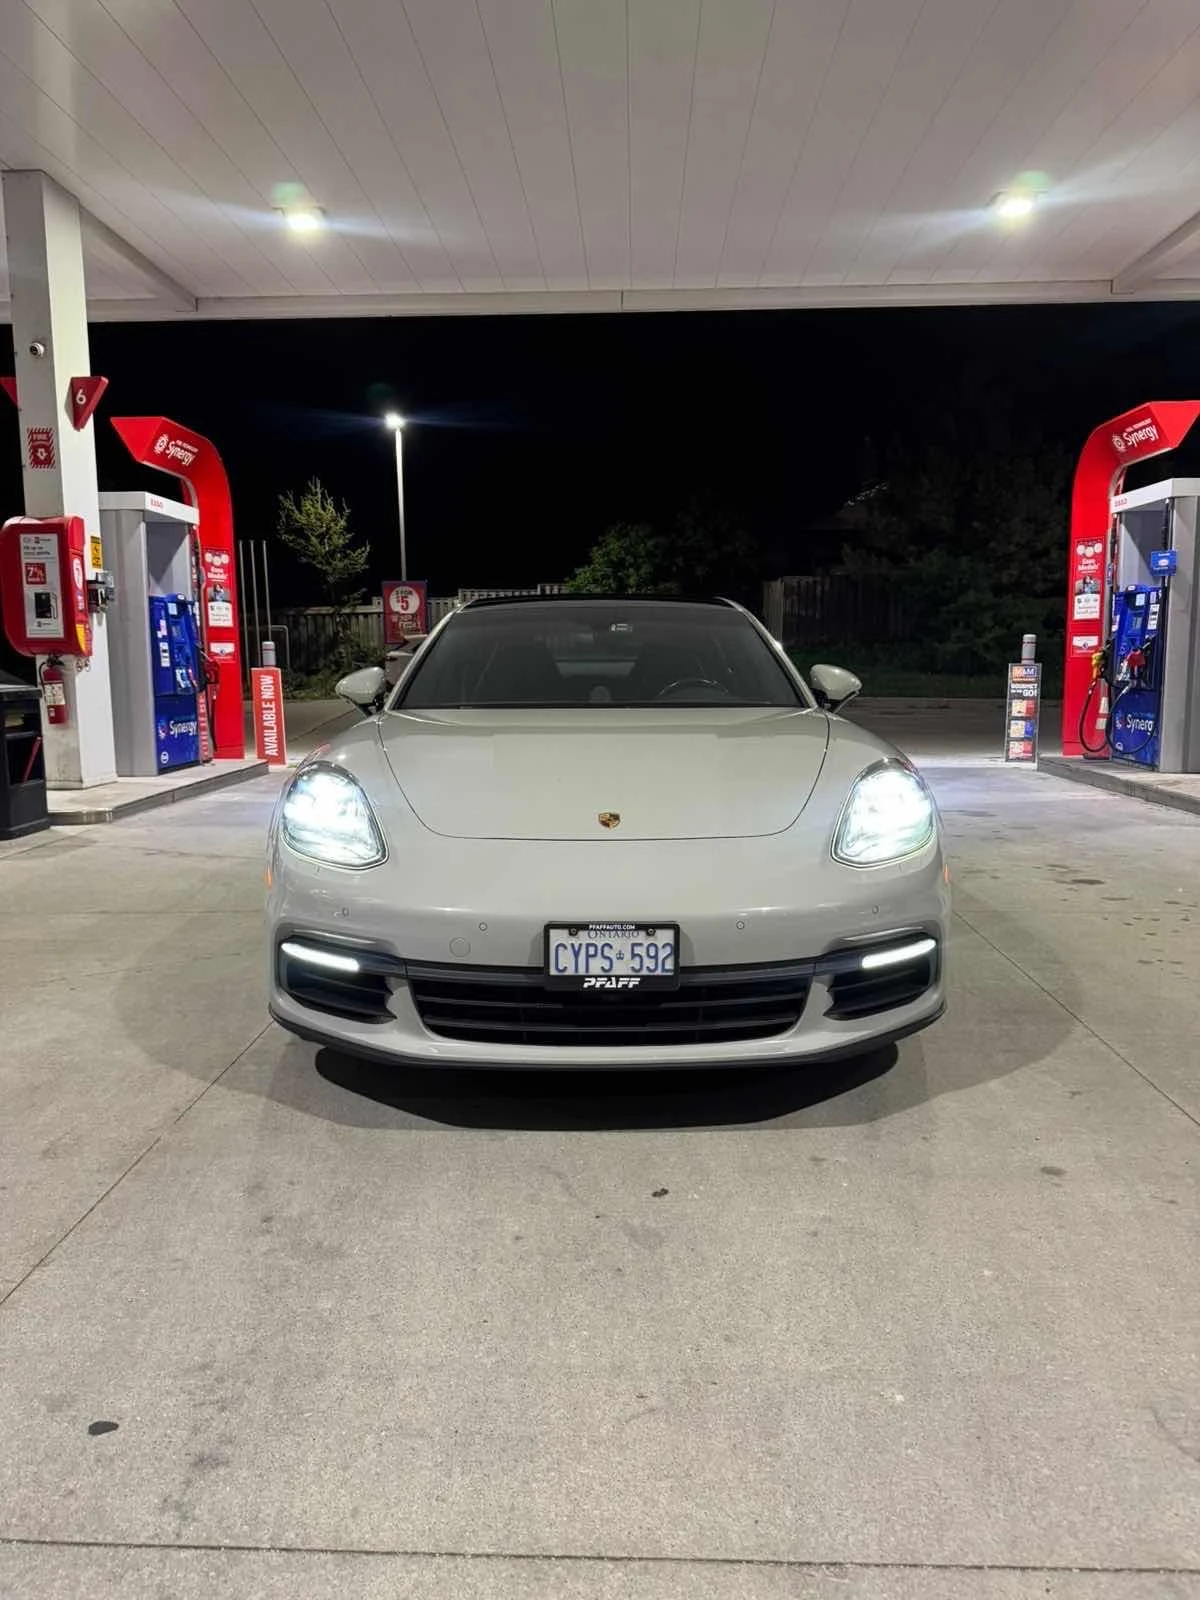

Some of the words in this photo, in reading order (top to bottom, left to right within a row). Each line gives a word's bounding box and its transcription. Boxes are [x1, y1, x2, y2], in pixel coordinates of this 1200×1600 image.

[76, 389, 86, 405] 6
[1122, 425, 1160, 448] Synergy
[165, 440, 196, 467] Synergy
[260, 674, 275, 699] NOW
[169, 720, 198, 736] Synergy
[262, 701, 279, 756] AVAILABLE
[1126, 714, 1156, 736] Synerg
[587, 930, 640, 939] ONTARIO
[554, 942, 613, 974] CYPS
[630, 942, 674, 974] 592
[583, 976, 640, 989] PFAFF
